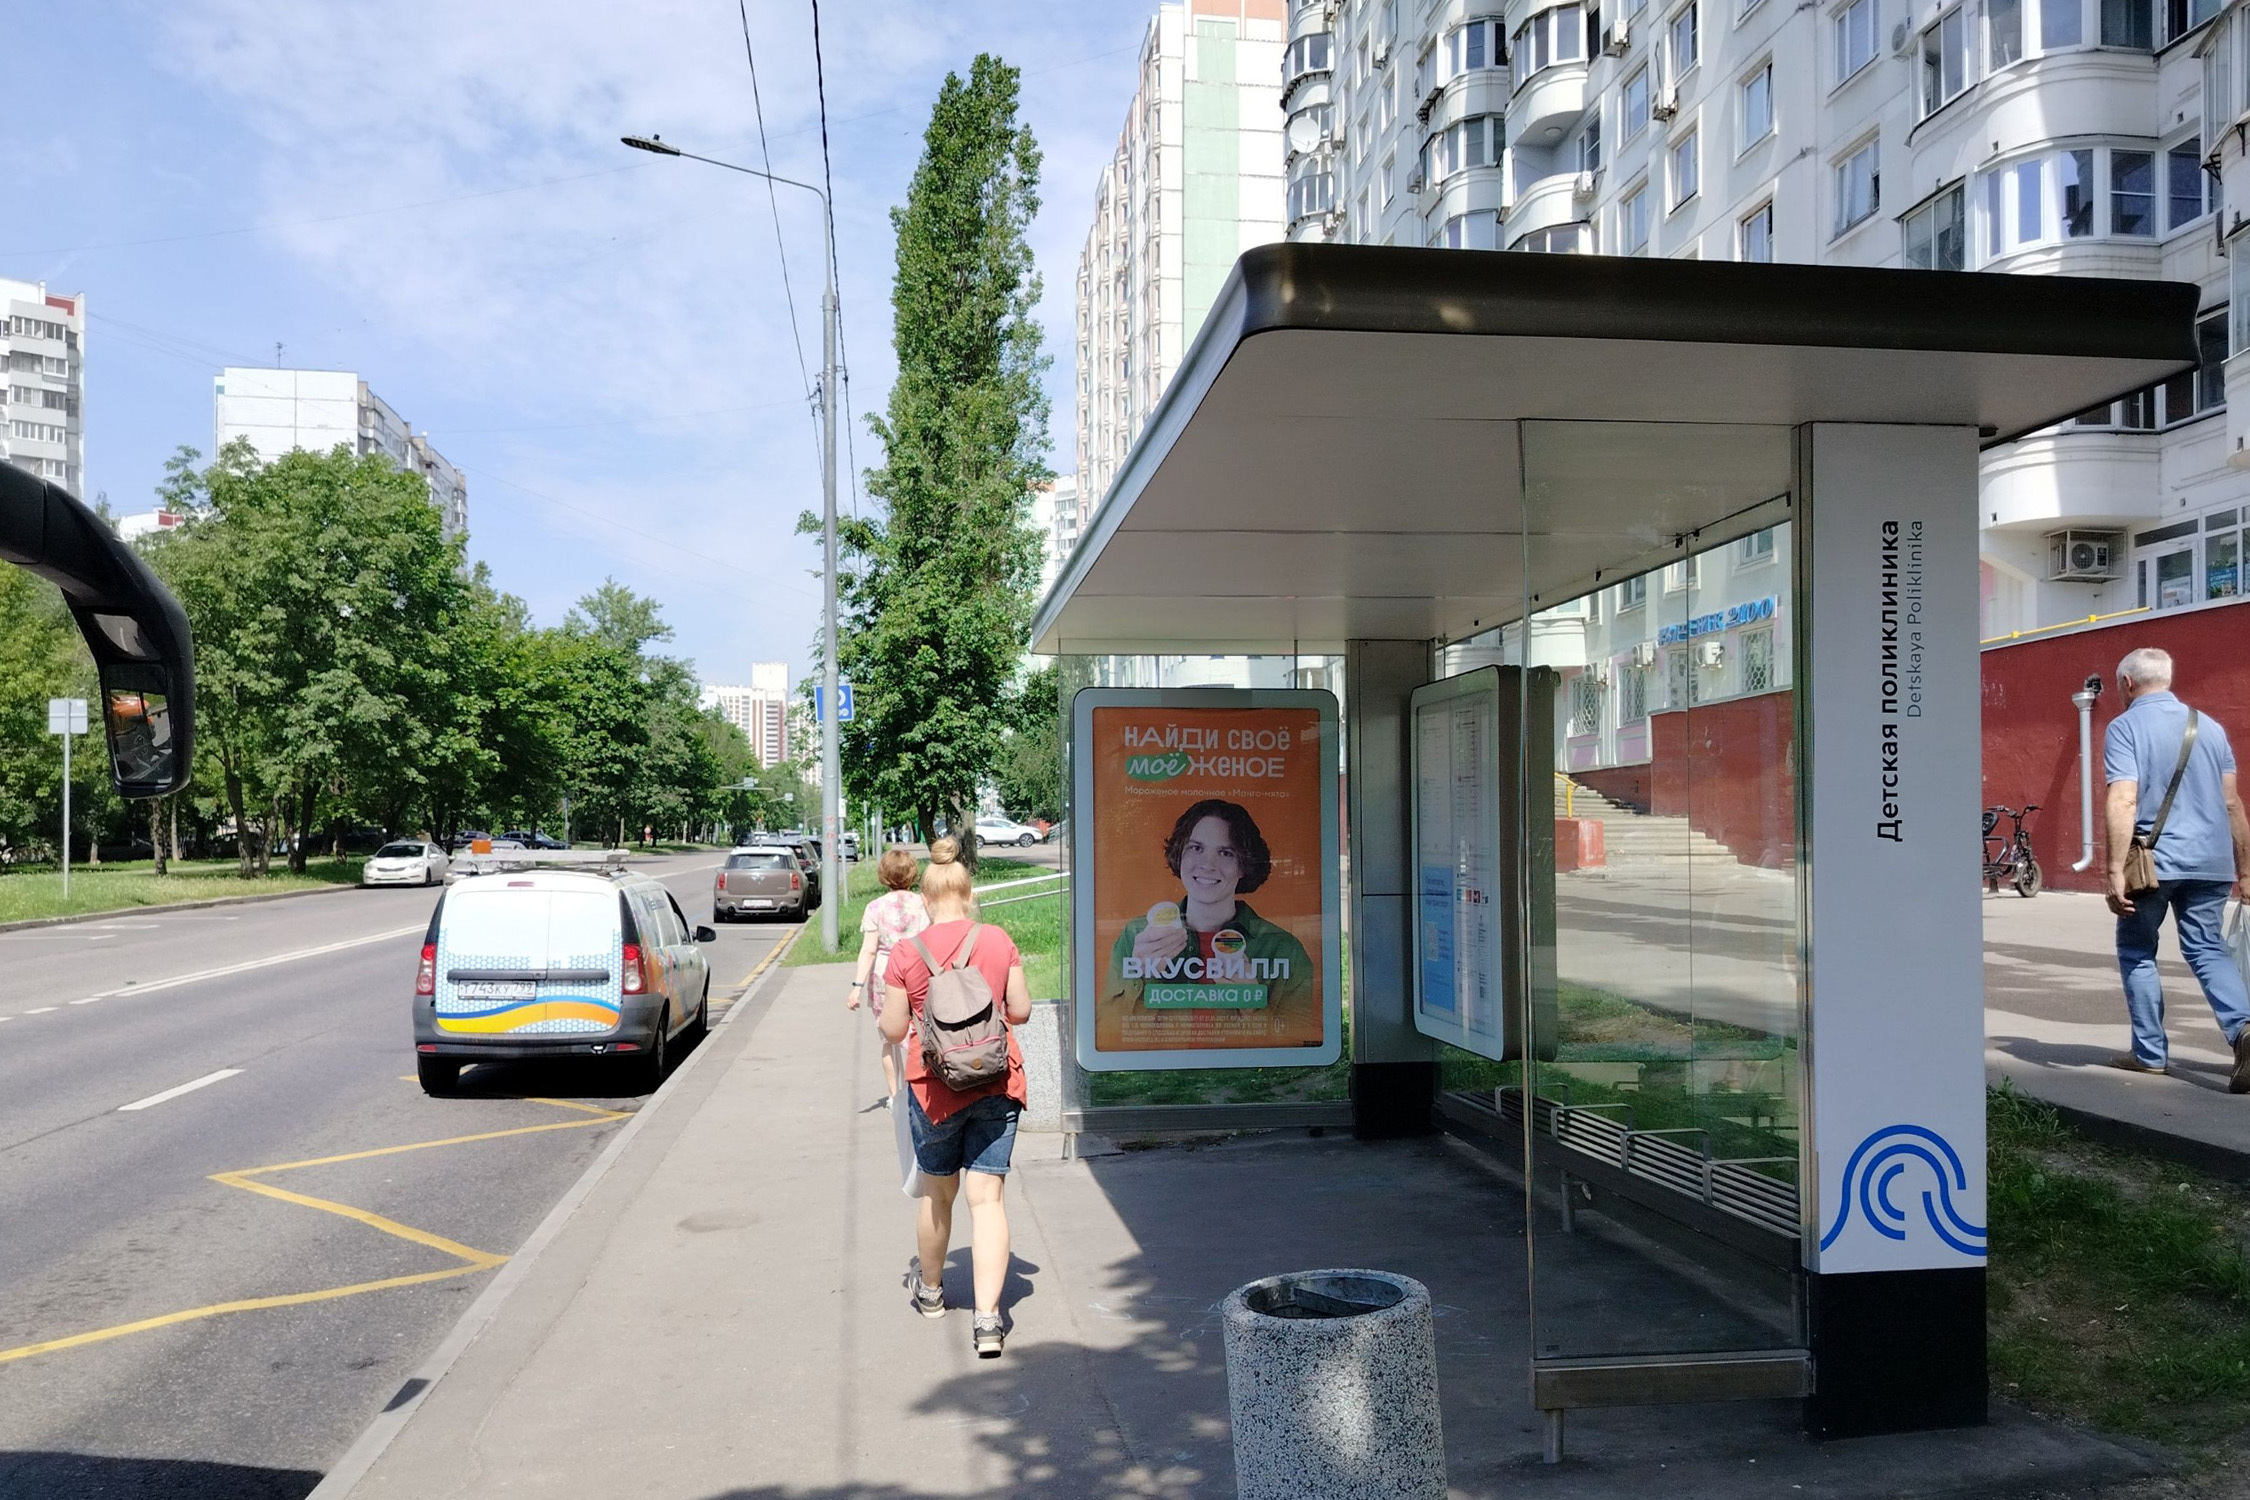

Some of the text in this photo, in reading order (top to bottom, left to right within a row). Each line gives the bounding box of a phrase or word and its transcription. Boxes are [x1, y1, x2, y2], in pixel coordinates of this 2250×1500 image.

[1906, 520, 1925, 718] Detskaya Poliklinika
[1877, 520, 1903, 842] Детская поликлиника
[1124, 723, 1219, 753] НАЙДИ
[1122, 956, 1290, 980] ВКУСВИЛЛ
[1273, 1017, 1286, 1034] 0+
